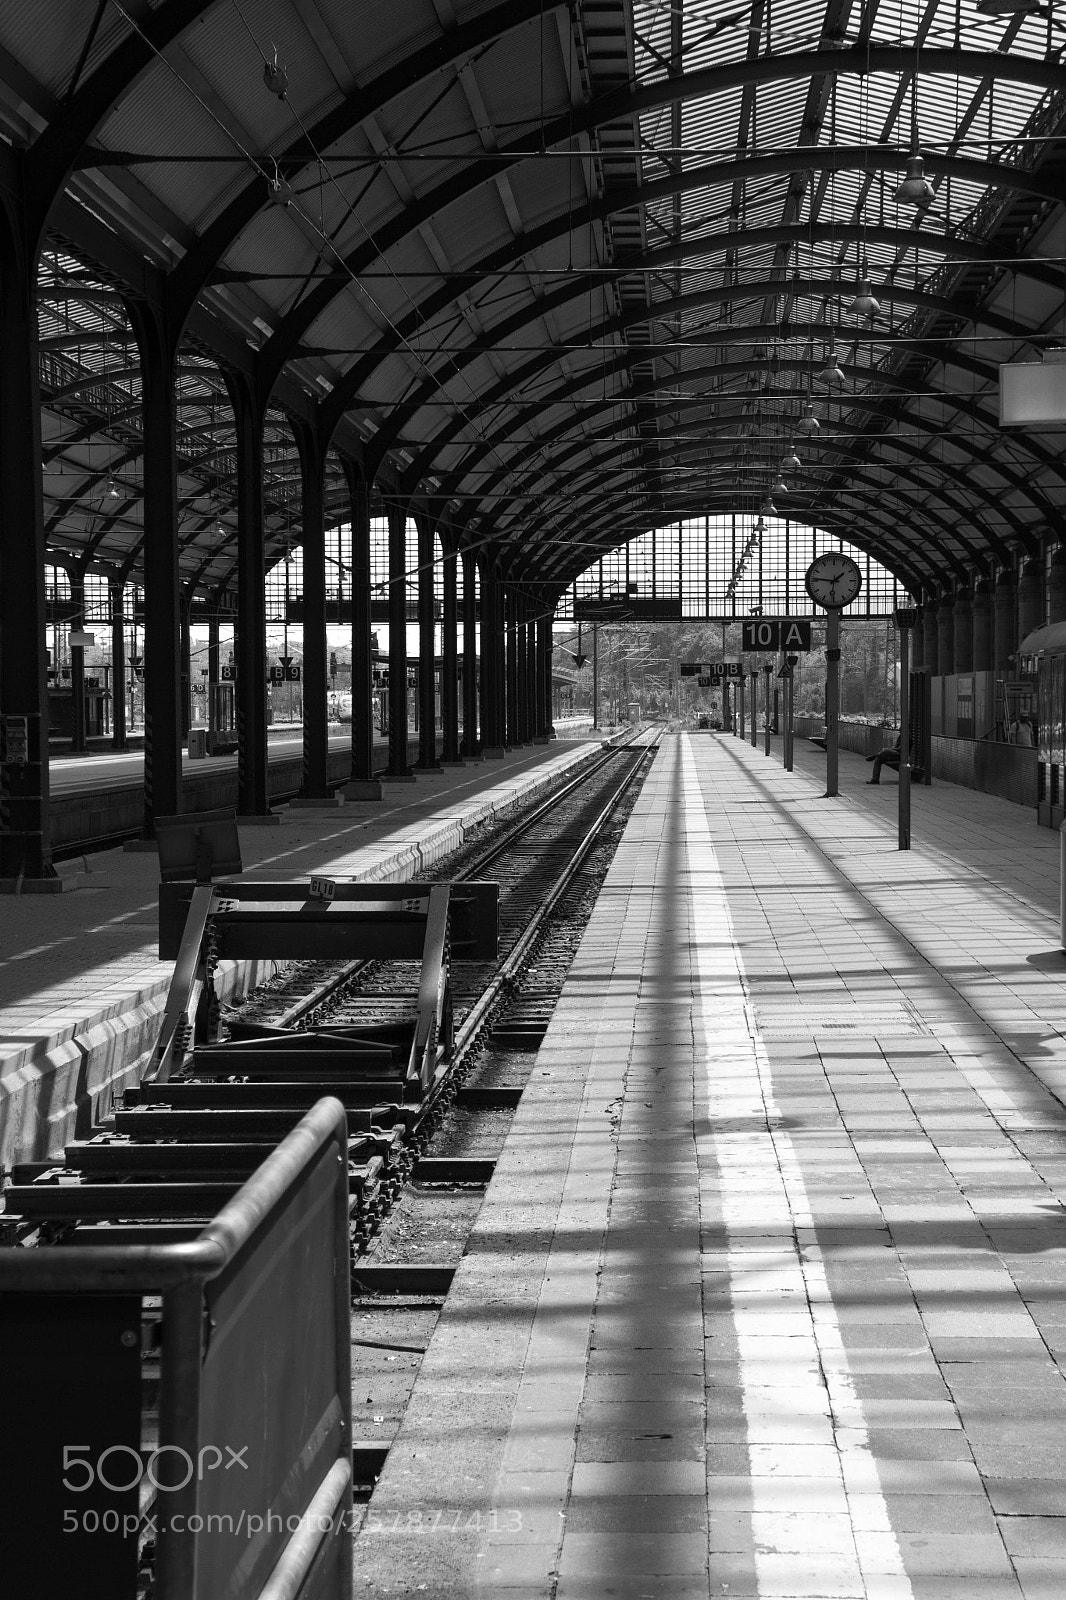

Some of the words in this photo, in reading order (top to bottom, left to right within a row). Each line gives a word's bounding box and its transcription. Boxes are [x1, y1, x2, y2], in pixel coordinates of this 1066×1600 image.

[746, 623, 772, 646] 10
[785, 623, 803, 645] A
[223, 667, 231, 678] 8
[275, 667, 284, 679] B
[291, 667, 299, 679] 9
[711, 664, 724, 675] 10
[729, 664, 738, 675] B
[699, 677, 709, 686] 10
[711, 677, 718, 685] C
